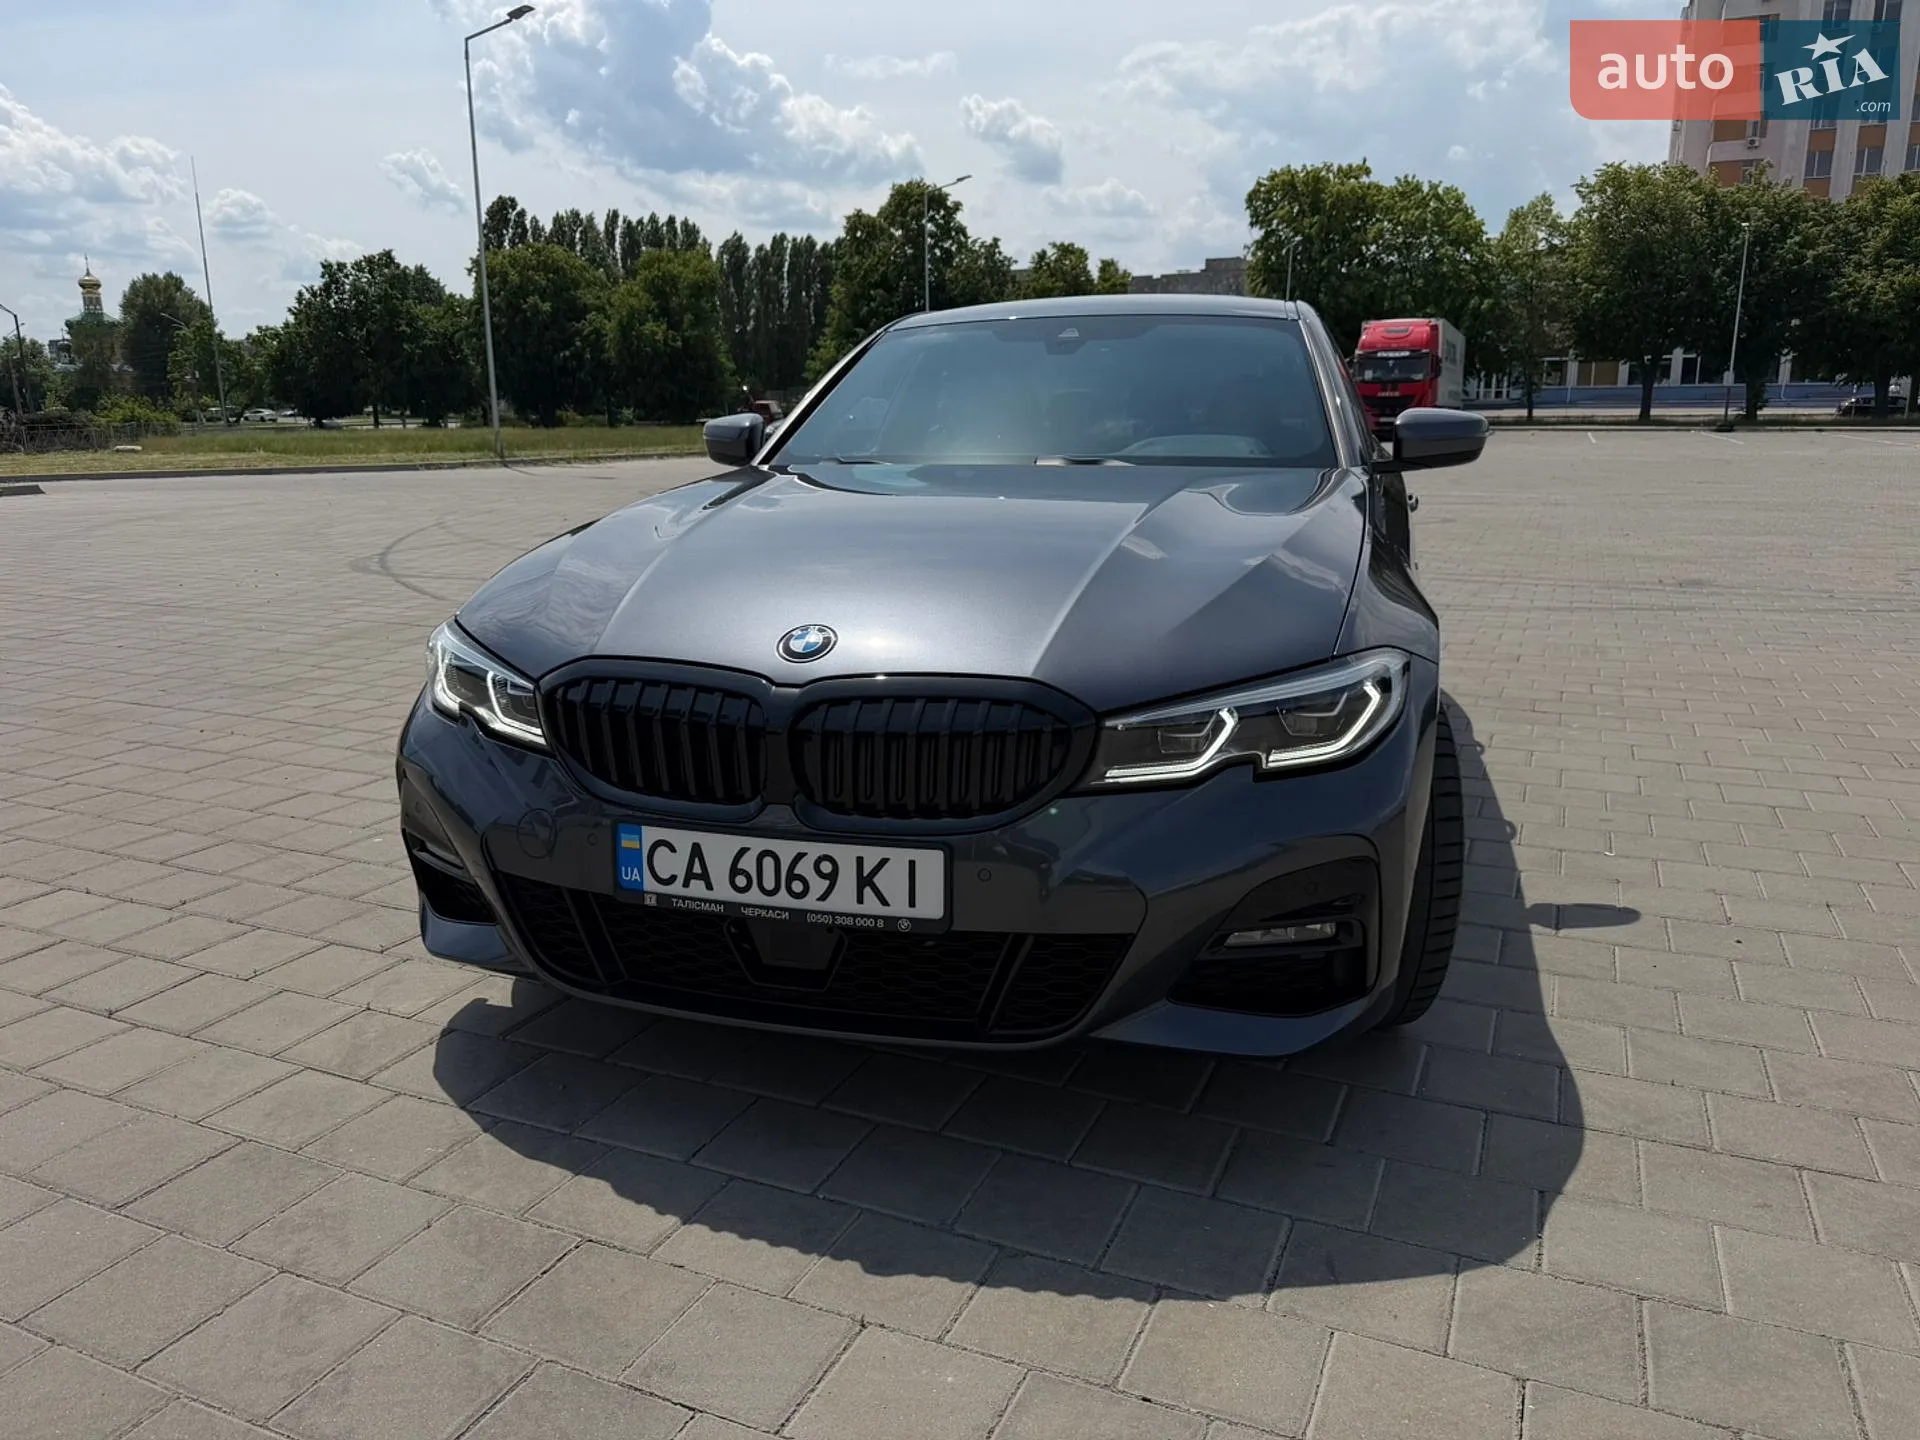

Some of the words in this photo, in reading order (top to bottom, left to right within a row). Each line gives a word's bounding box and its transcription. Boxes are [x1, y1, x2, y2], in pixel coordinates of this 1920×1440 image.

[622, 866, 641, 883] UA
[647, 839, 714, 891] CA
[728, 847, 840, 902] 6069
[856, 856, 916, 908] KI
[671, 898, 725, 914] ТАЛІСМАН
[740, 906, 790, 921] ЧЕРКАСИ
[806, 913, 833, 925] (050)
[855, 917, 875, 927] 000
